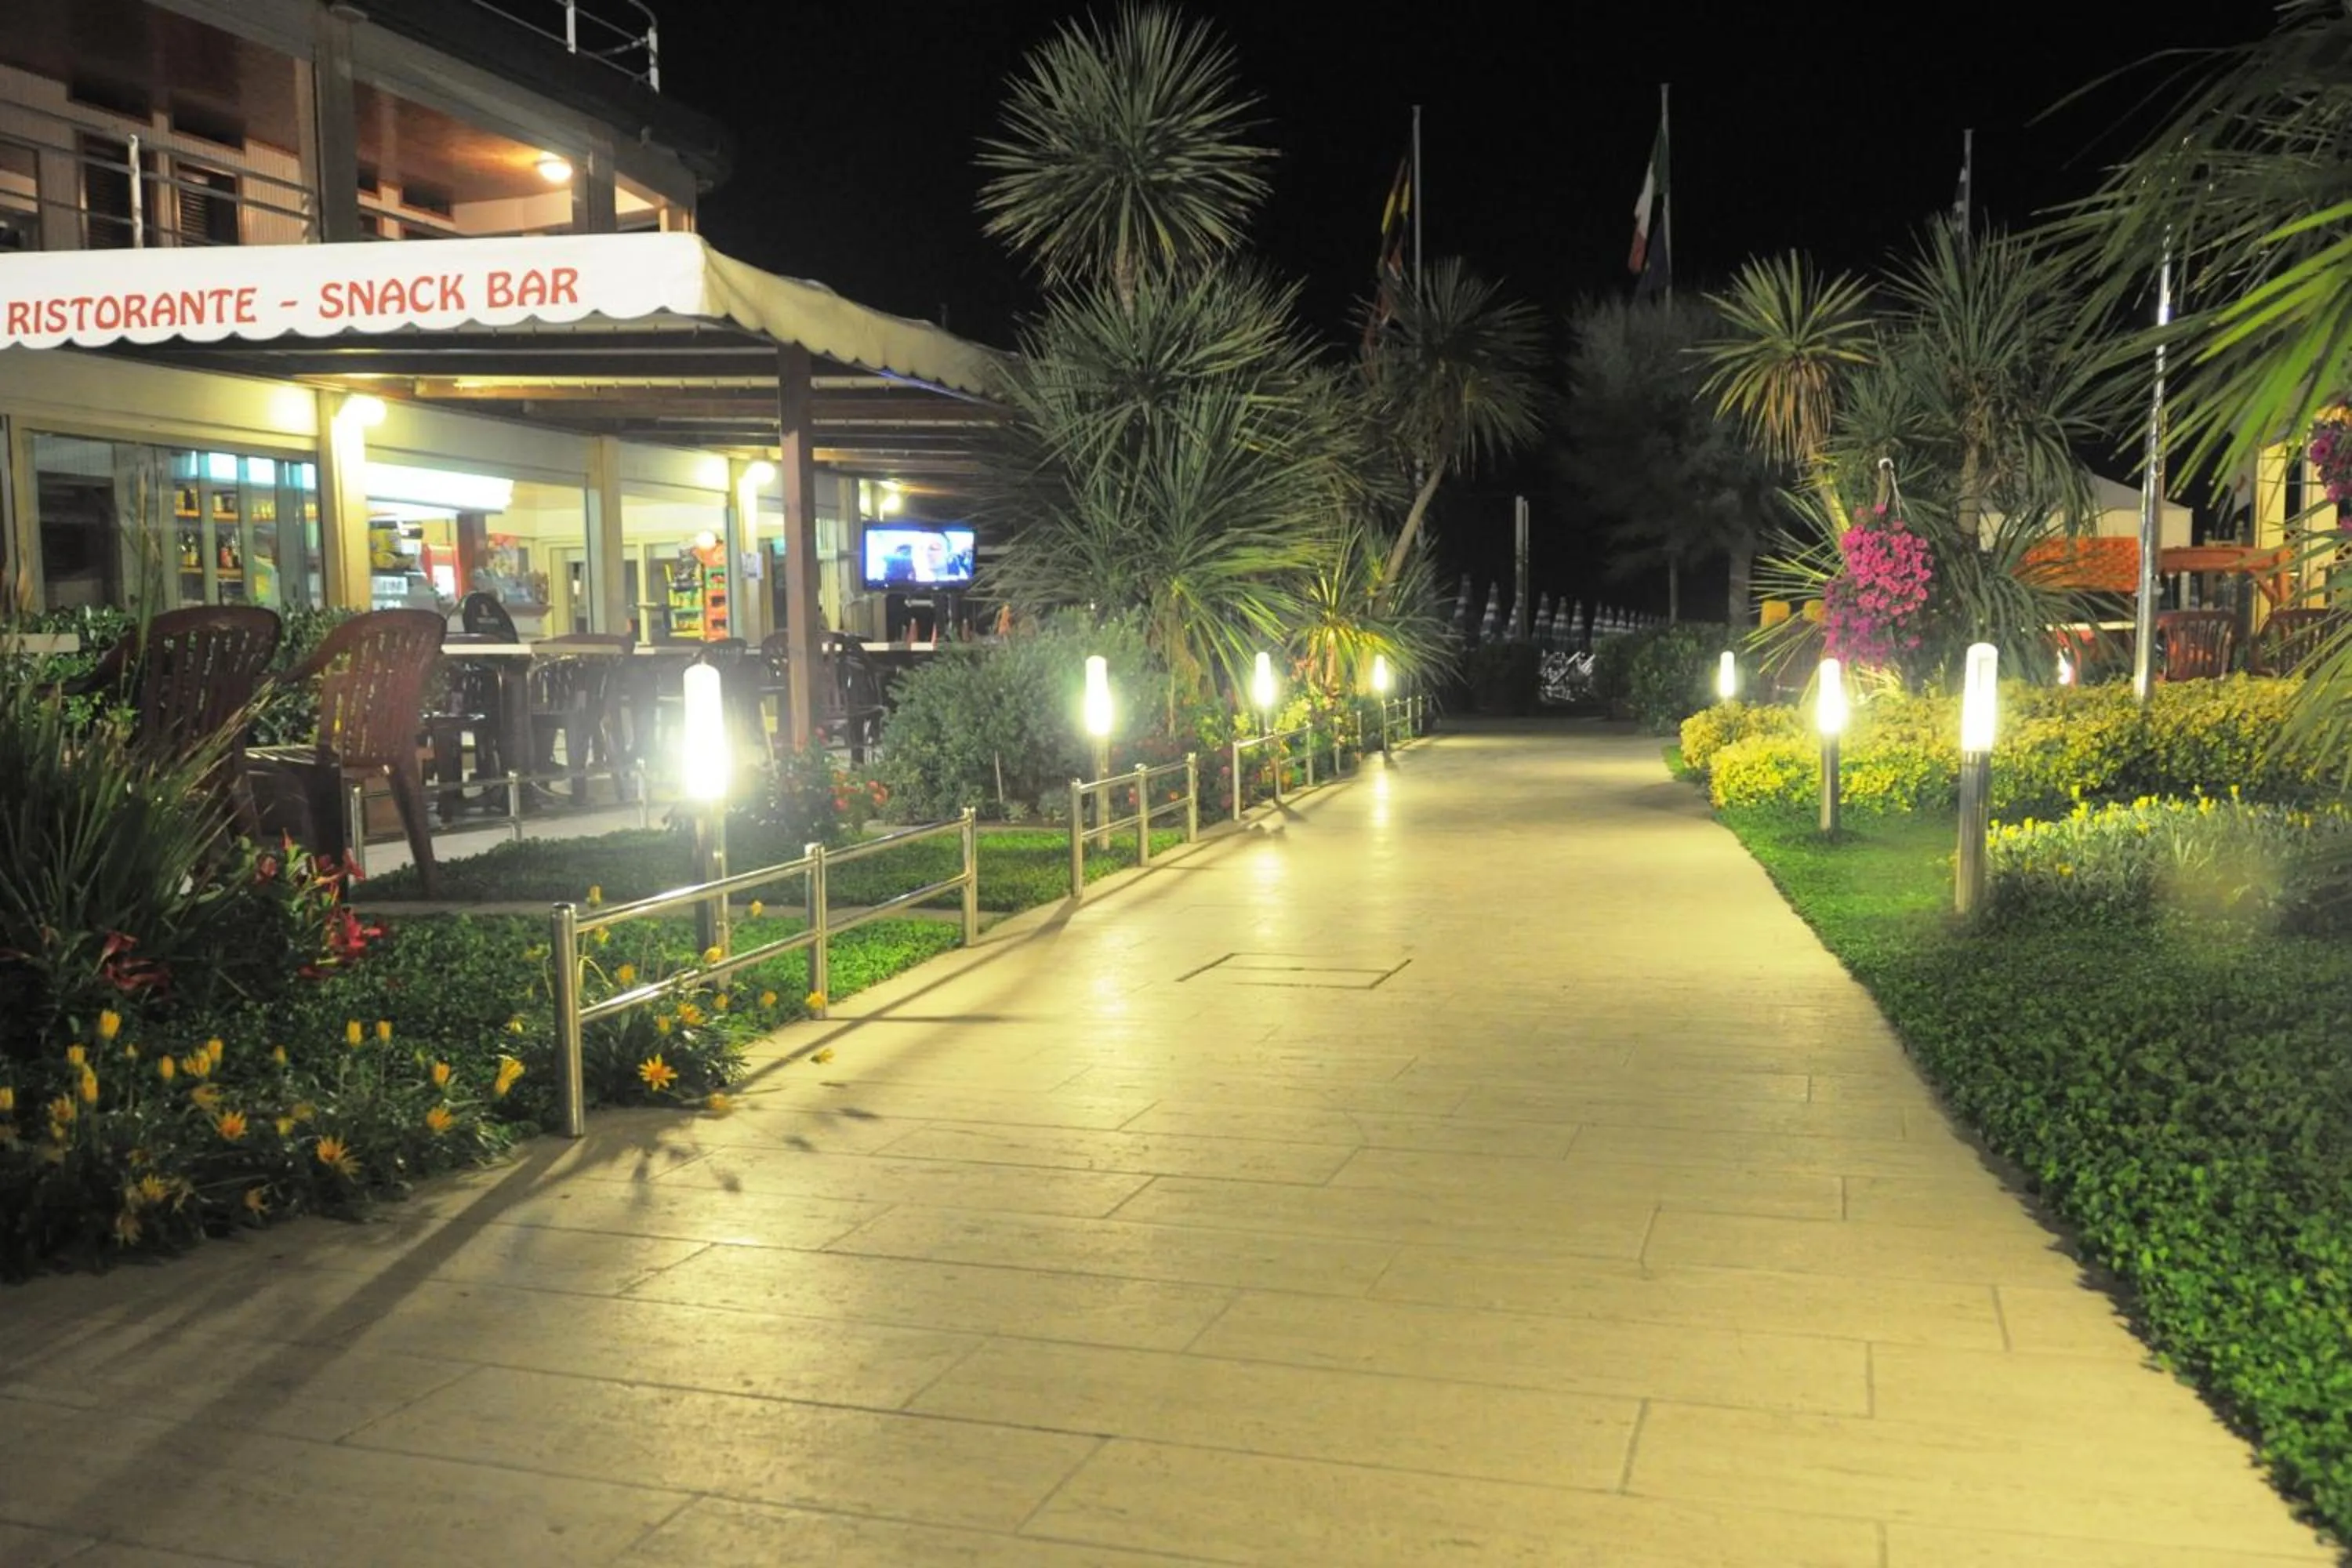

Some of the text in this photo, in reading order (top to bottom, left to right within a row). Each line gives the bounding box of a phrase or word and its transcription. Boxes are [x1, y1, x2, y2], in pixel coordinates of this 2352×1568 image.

[7, 287, 257, 336] RISTORANTE
[320, 275, 465, 318] SNACK
[487, 267, 579, 308] BAR
